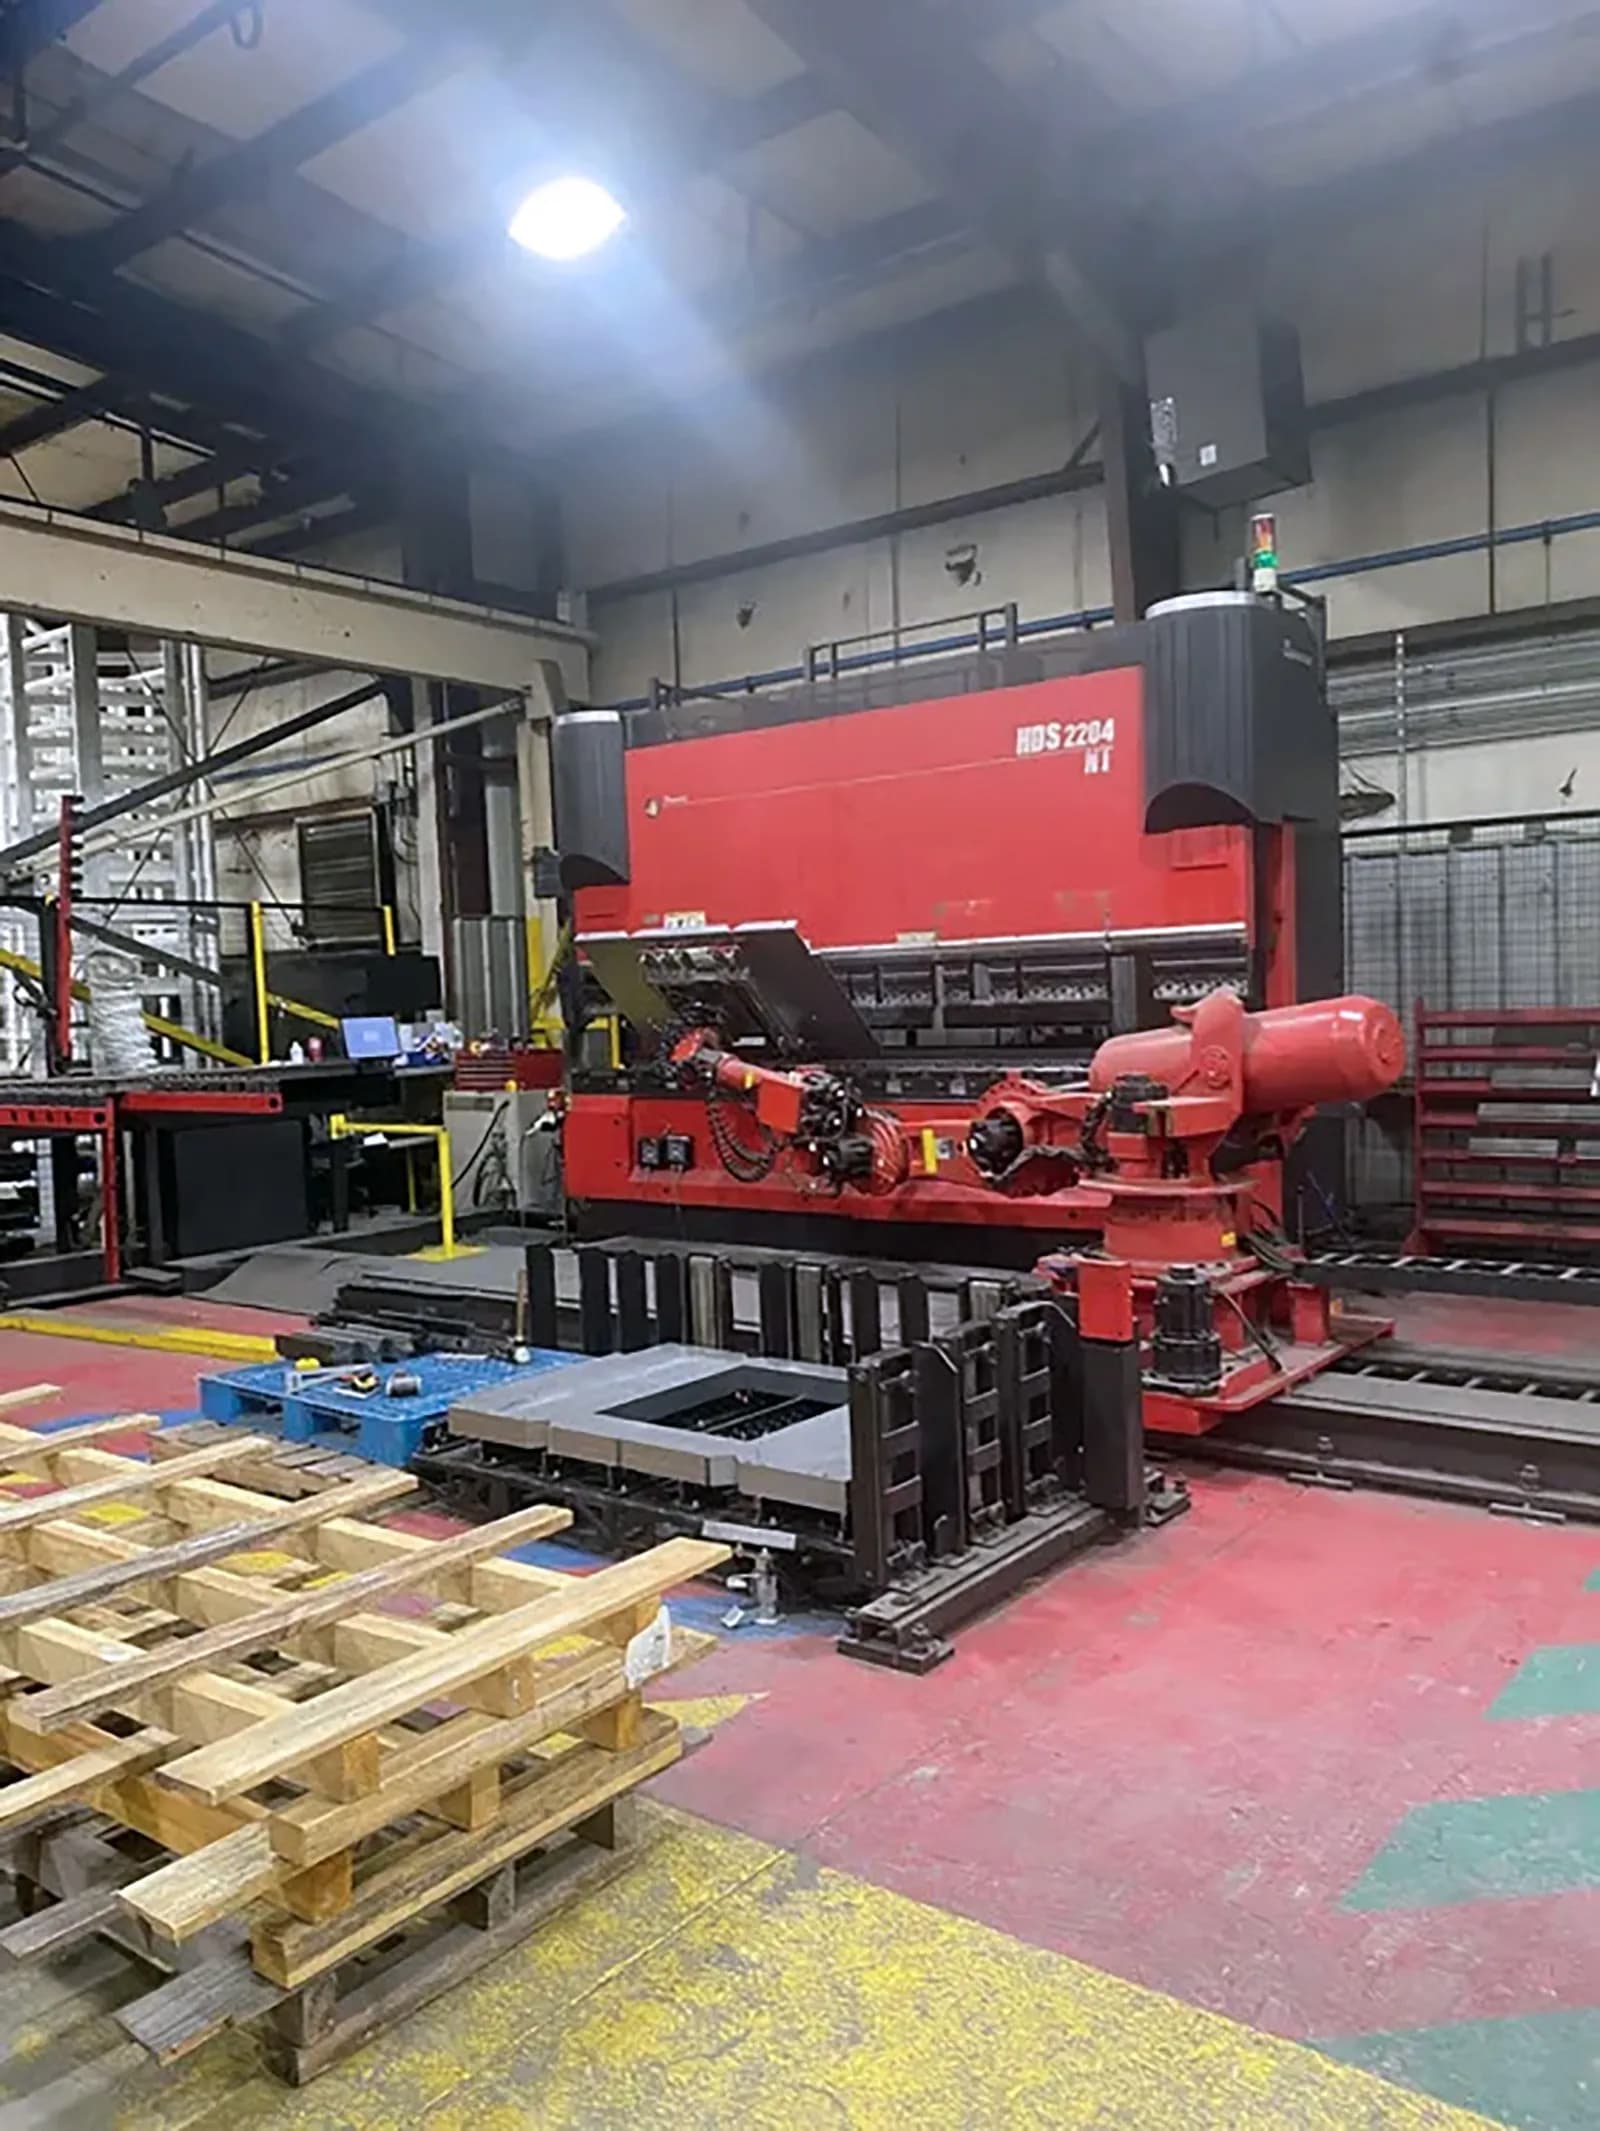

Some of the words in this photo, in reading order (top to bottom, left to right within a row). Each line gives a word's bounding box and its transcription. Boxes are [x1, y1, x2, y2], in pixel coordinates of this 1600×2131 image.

[1015, 722, 1061, 756] HDS
[1063, 718, 1114, 748] 2204
[1084, 746, 1113, 775] NT
